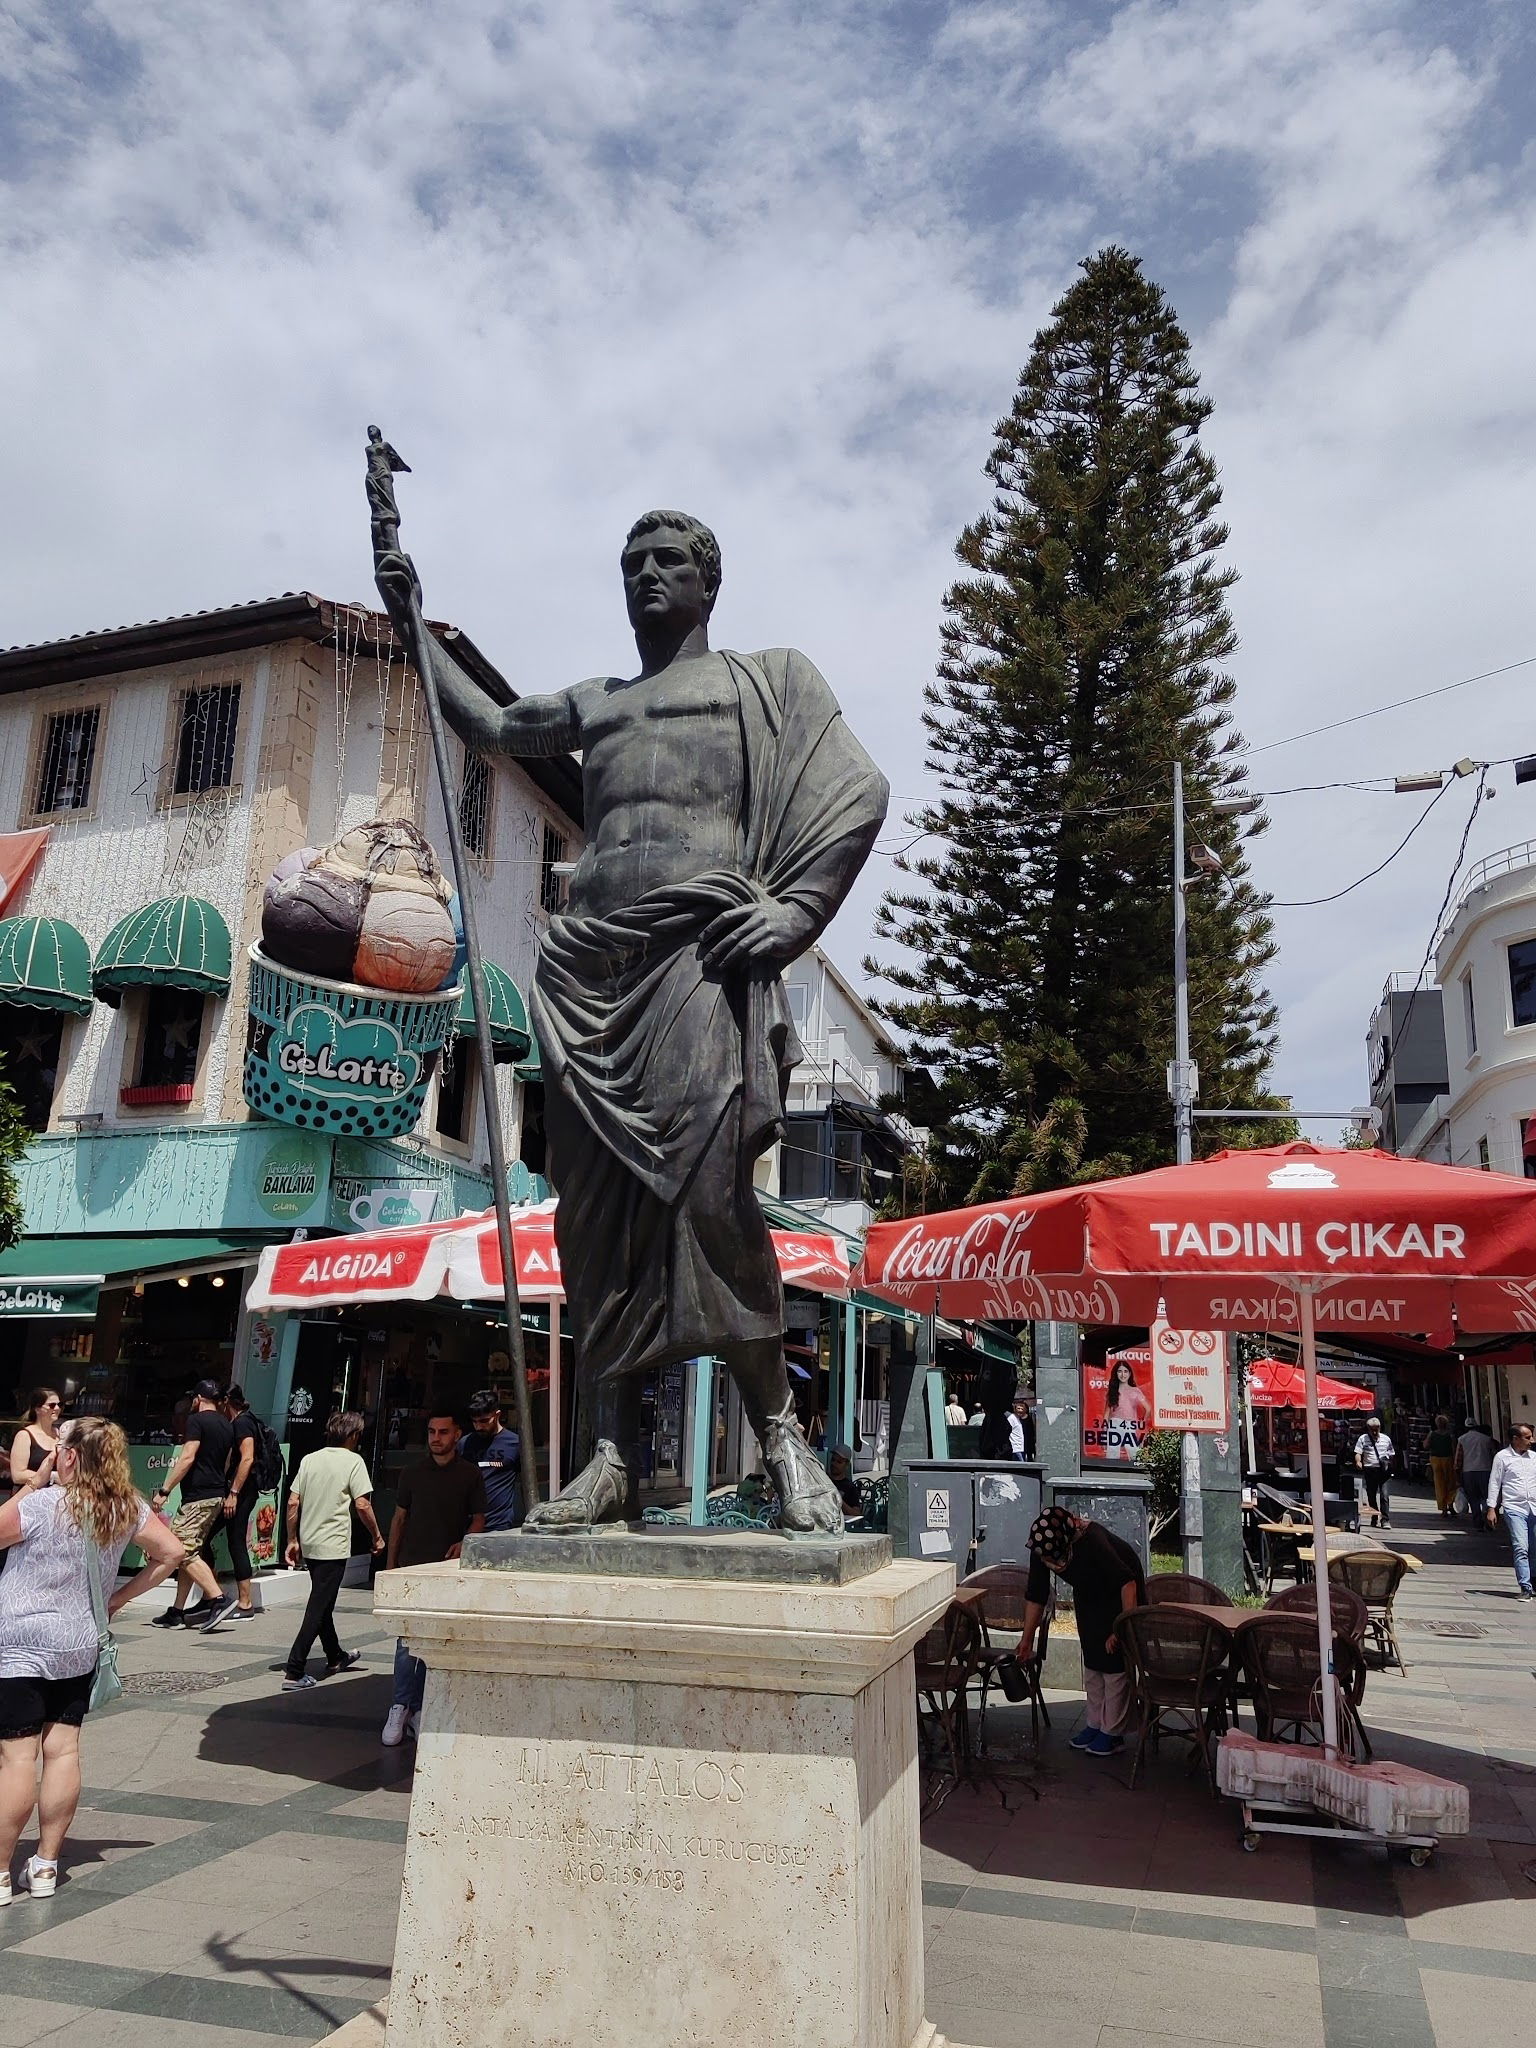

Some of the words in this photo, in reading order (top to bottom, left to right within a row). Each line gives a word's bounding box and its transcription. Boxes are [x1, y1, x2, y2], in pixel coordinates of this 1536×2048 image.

[280, 1043, 405, 1089] GeLatte
[262, 1174, 316, 1195] BAKLAVA
[882, 1210, 1037, 1284] Coca-Cola
[1150, 1222, 1302, 1257] TADINI
[1316, 1222, 1466, 1265] ÇIKAR
[1168, 1364, 1209, 1376] Motosiklet
[1183, 1382, 1193, 1391] ve
[1174, 1394, 1204, 1406] Bisiklet
[1092, 1418, 1100, 1429] 3
[1100, 1418, 1117, 1429] AL
[1158, 1408, 1188, 1419] Girmesi
[562, 1751, 745, 1804] ATTALOS
[453, 1815, 553, 1843] ANTALYA
[559, 1822, 674, 1855] KENTİNİN
[612, 1864, 686, 1893] 159/158
